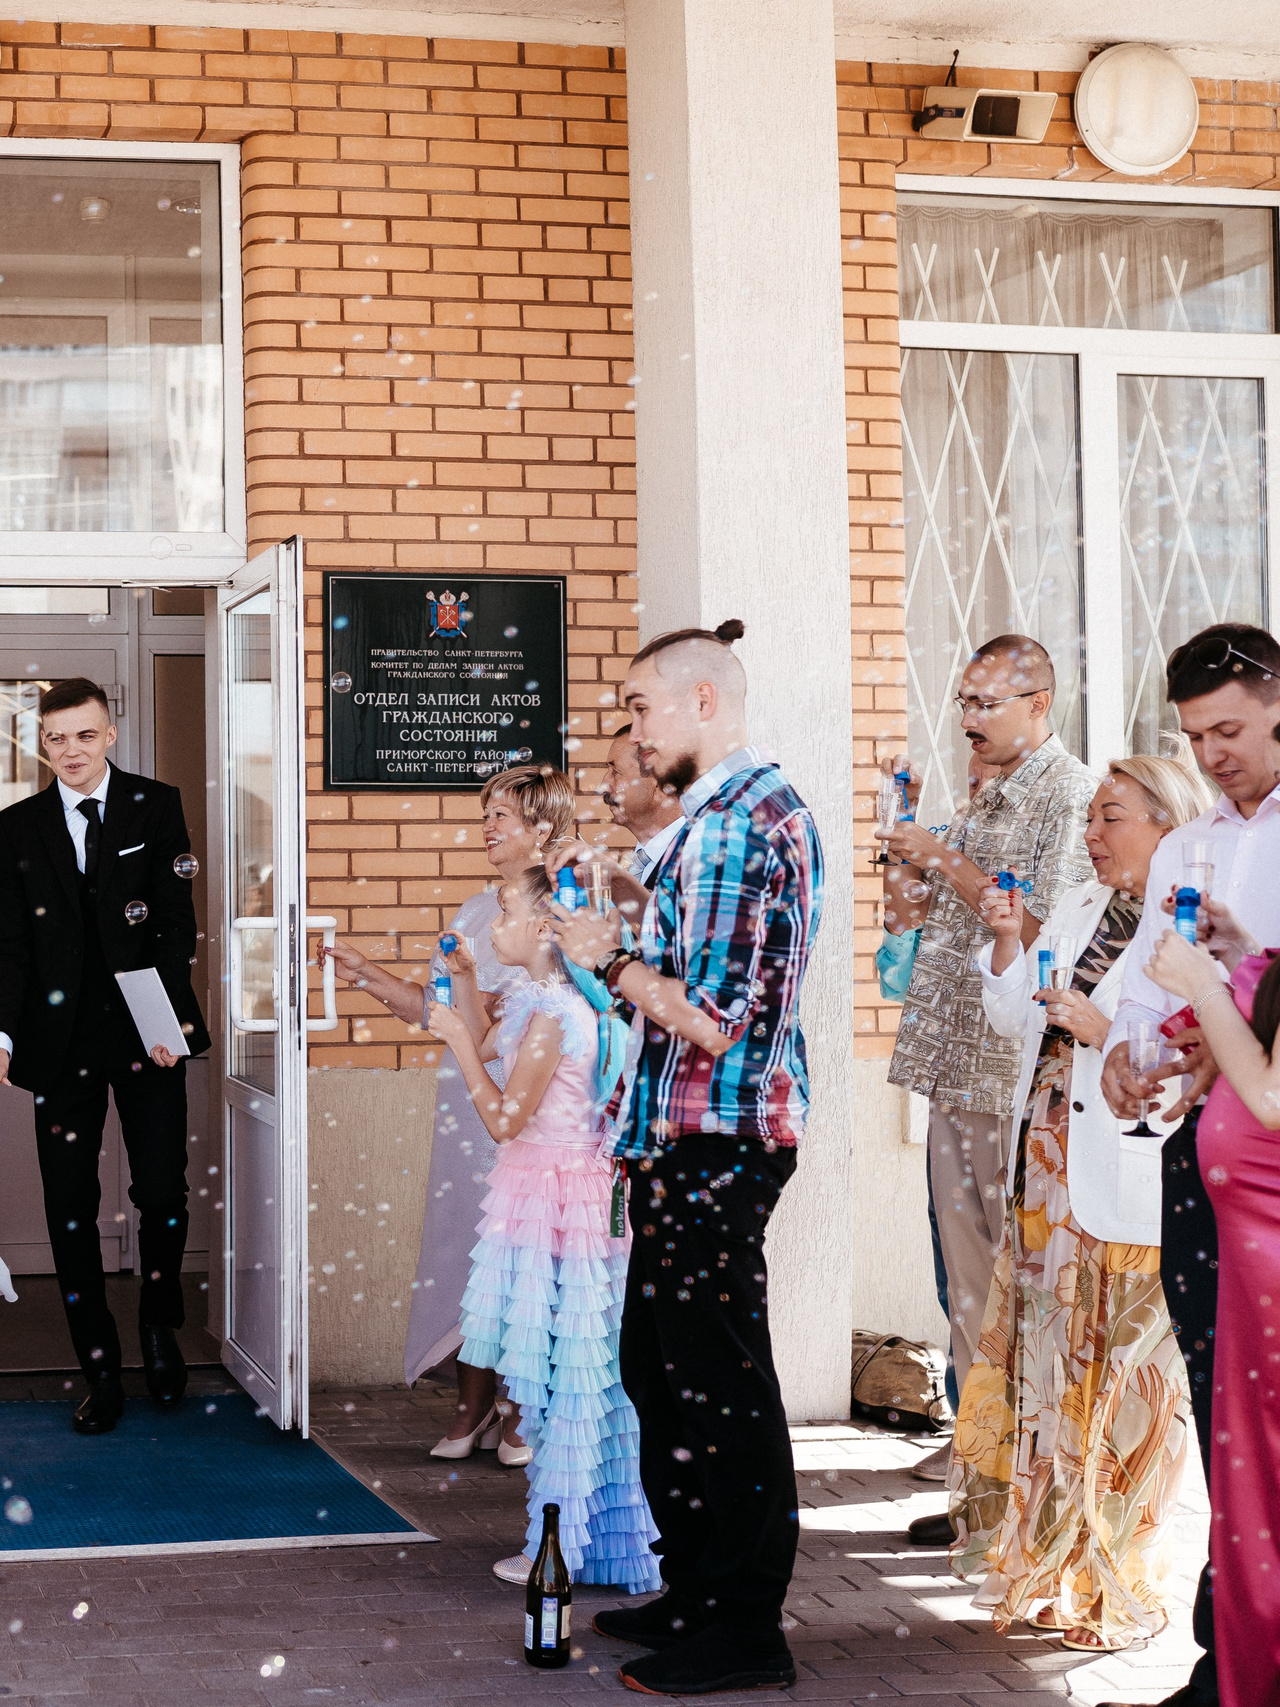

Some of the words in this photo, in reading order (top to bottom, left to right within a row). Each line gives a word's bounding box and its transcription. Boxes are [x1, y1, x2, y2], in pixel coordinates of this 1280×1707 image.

[444, 650, 523, 658] САНКТ-ПЕТЕРБУРГА
[371, 661, 409, 669] КОМИТЕТ
[427, 662, 457, 670] ДЕЛАМ
[462, 662, 494, 670] ЗАПИСИ
[497, 663, 524, 671] АКТОВ
[387, 671, 455, 679] ГРАЖДАНСКОГО
[459, 672, 508, 680] СОСТОЯНИЯ
[354, 692, 409, 707] ОТДЕЛ
[416, 693, 480, 706] ЗАПИСИ
[491, 694, 541, 707] АКТОВ
[382, 710, 514, 725] ГРАЖДАНСКОГО
[399, 729, 497, 742] СОСТОЯНИЯ
[376, 749, 466, 760] ПРИМОРСКОГО
